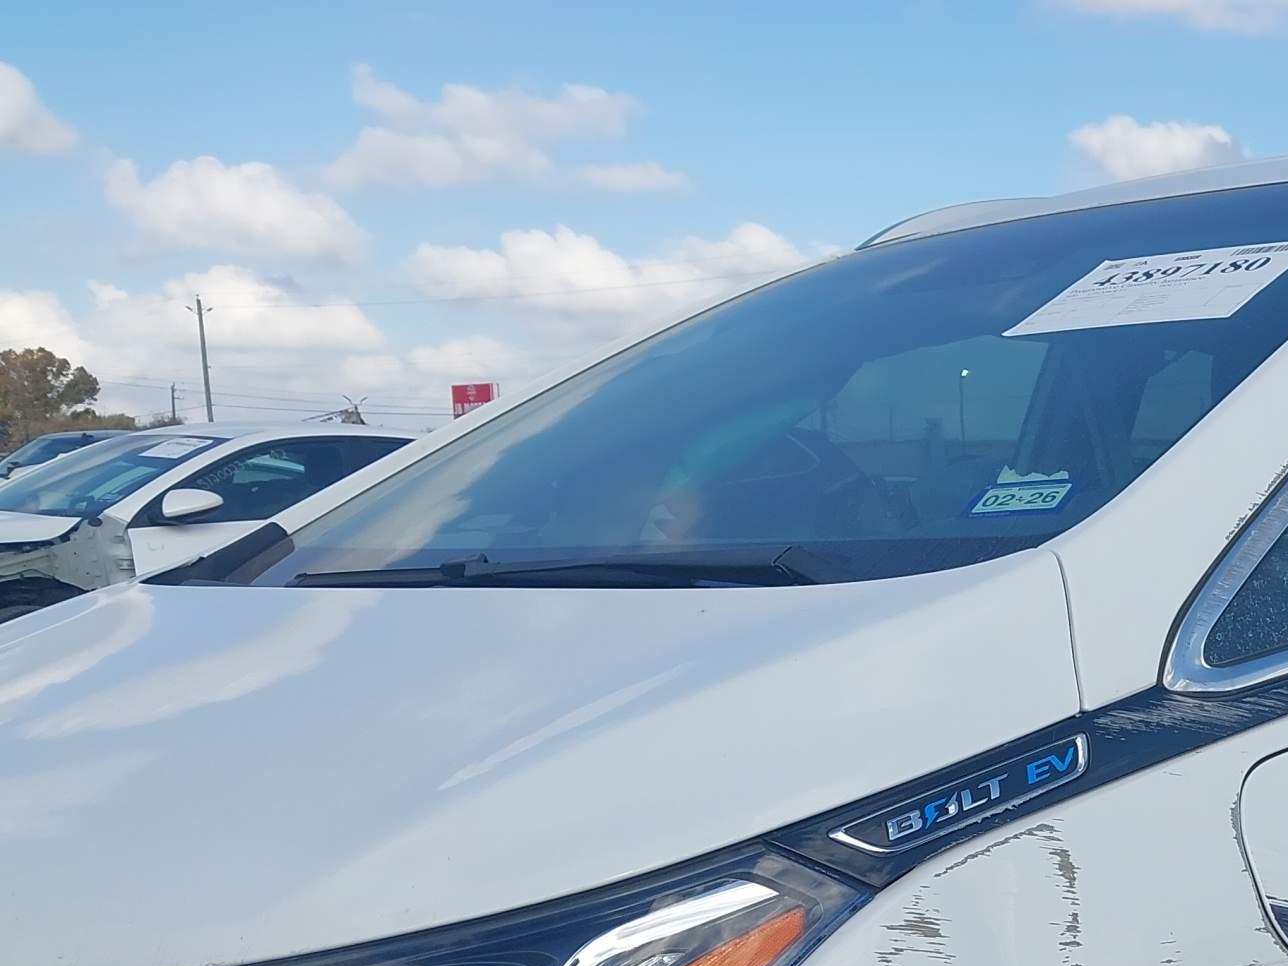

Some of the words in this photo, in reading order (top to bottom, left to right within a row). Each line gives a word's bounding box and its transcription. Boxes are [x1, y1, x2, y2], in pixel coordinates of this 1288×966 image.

[1093, 256, 1272, 287] 43897180
[886, 772, 1009, 841] BOLT
[1026, 747, 1074, 785] EV
